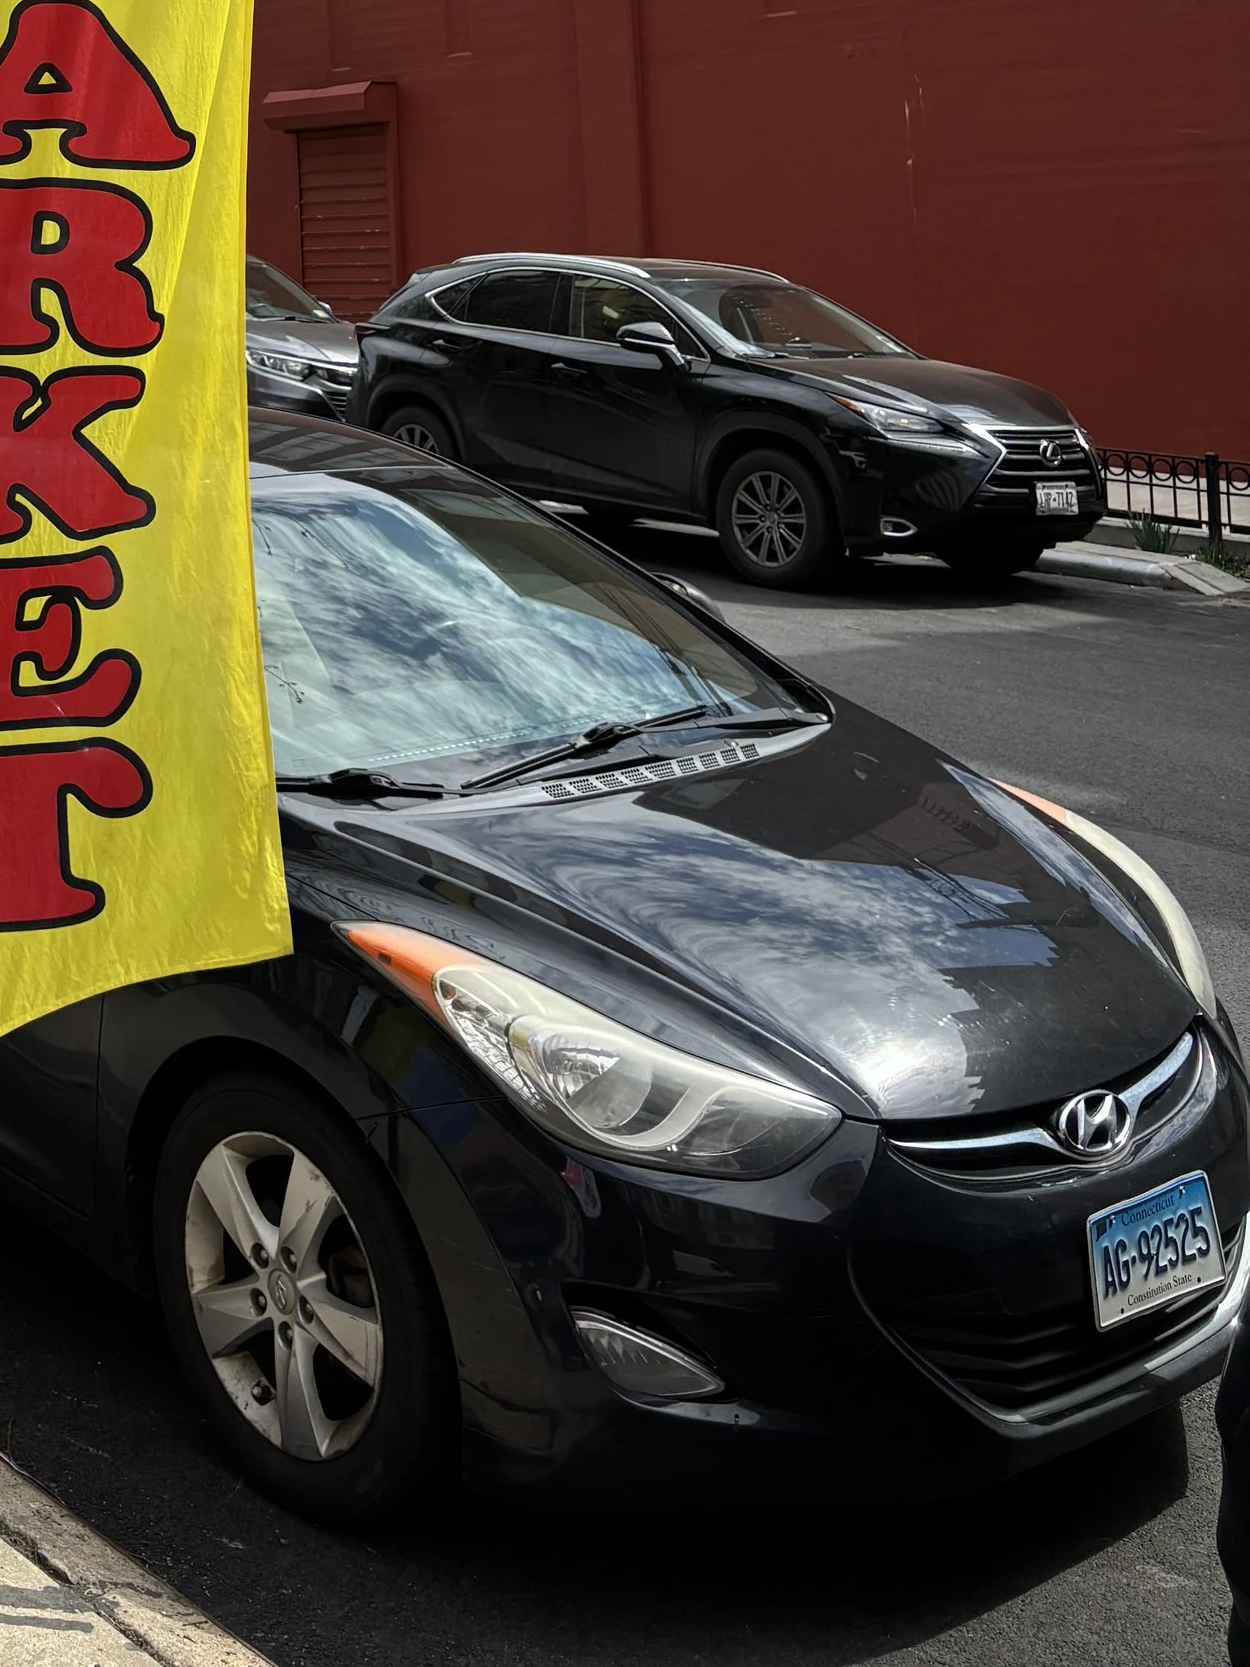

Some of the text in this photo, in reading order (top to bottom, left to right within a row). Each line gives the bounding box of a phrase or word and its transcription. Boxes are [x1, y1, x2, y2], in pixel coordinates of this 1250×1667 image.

[1121, 1195, 1175, 1226] Connecticut
[1127, 1273, 1193, 1306] Constitution State
